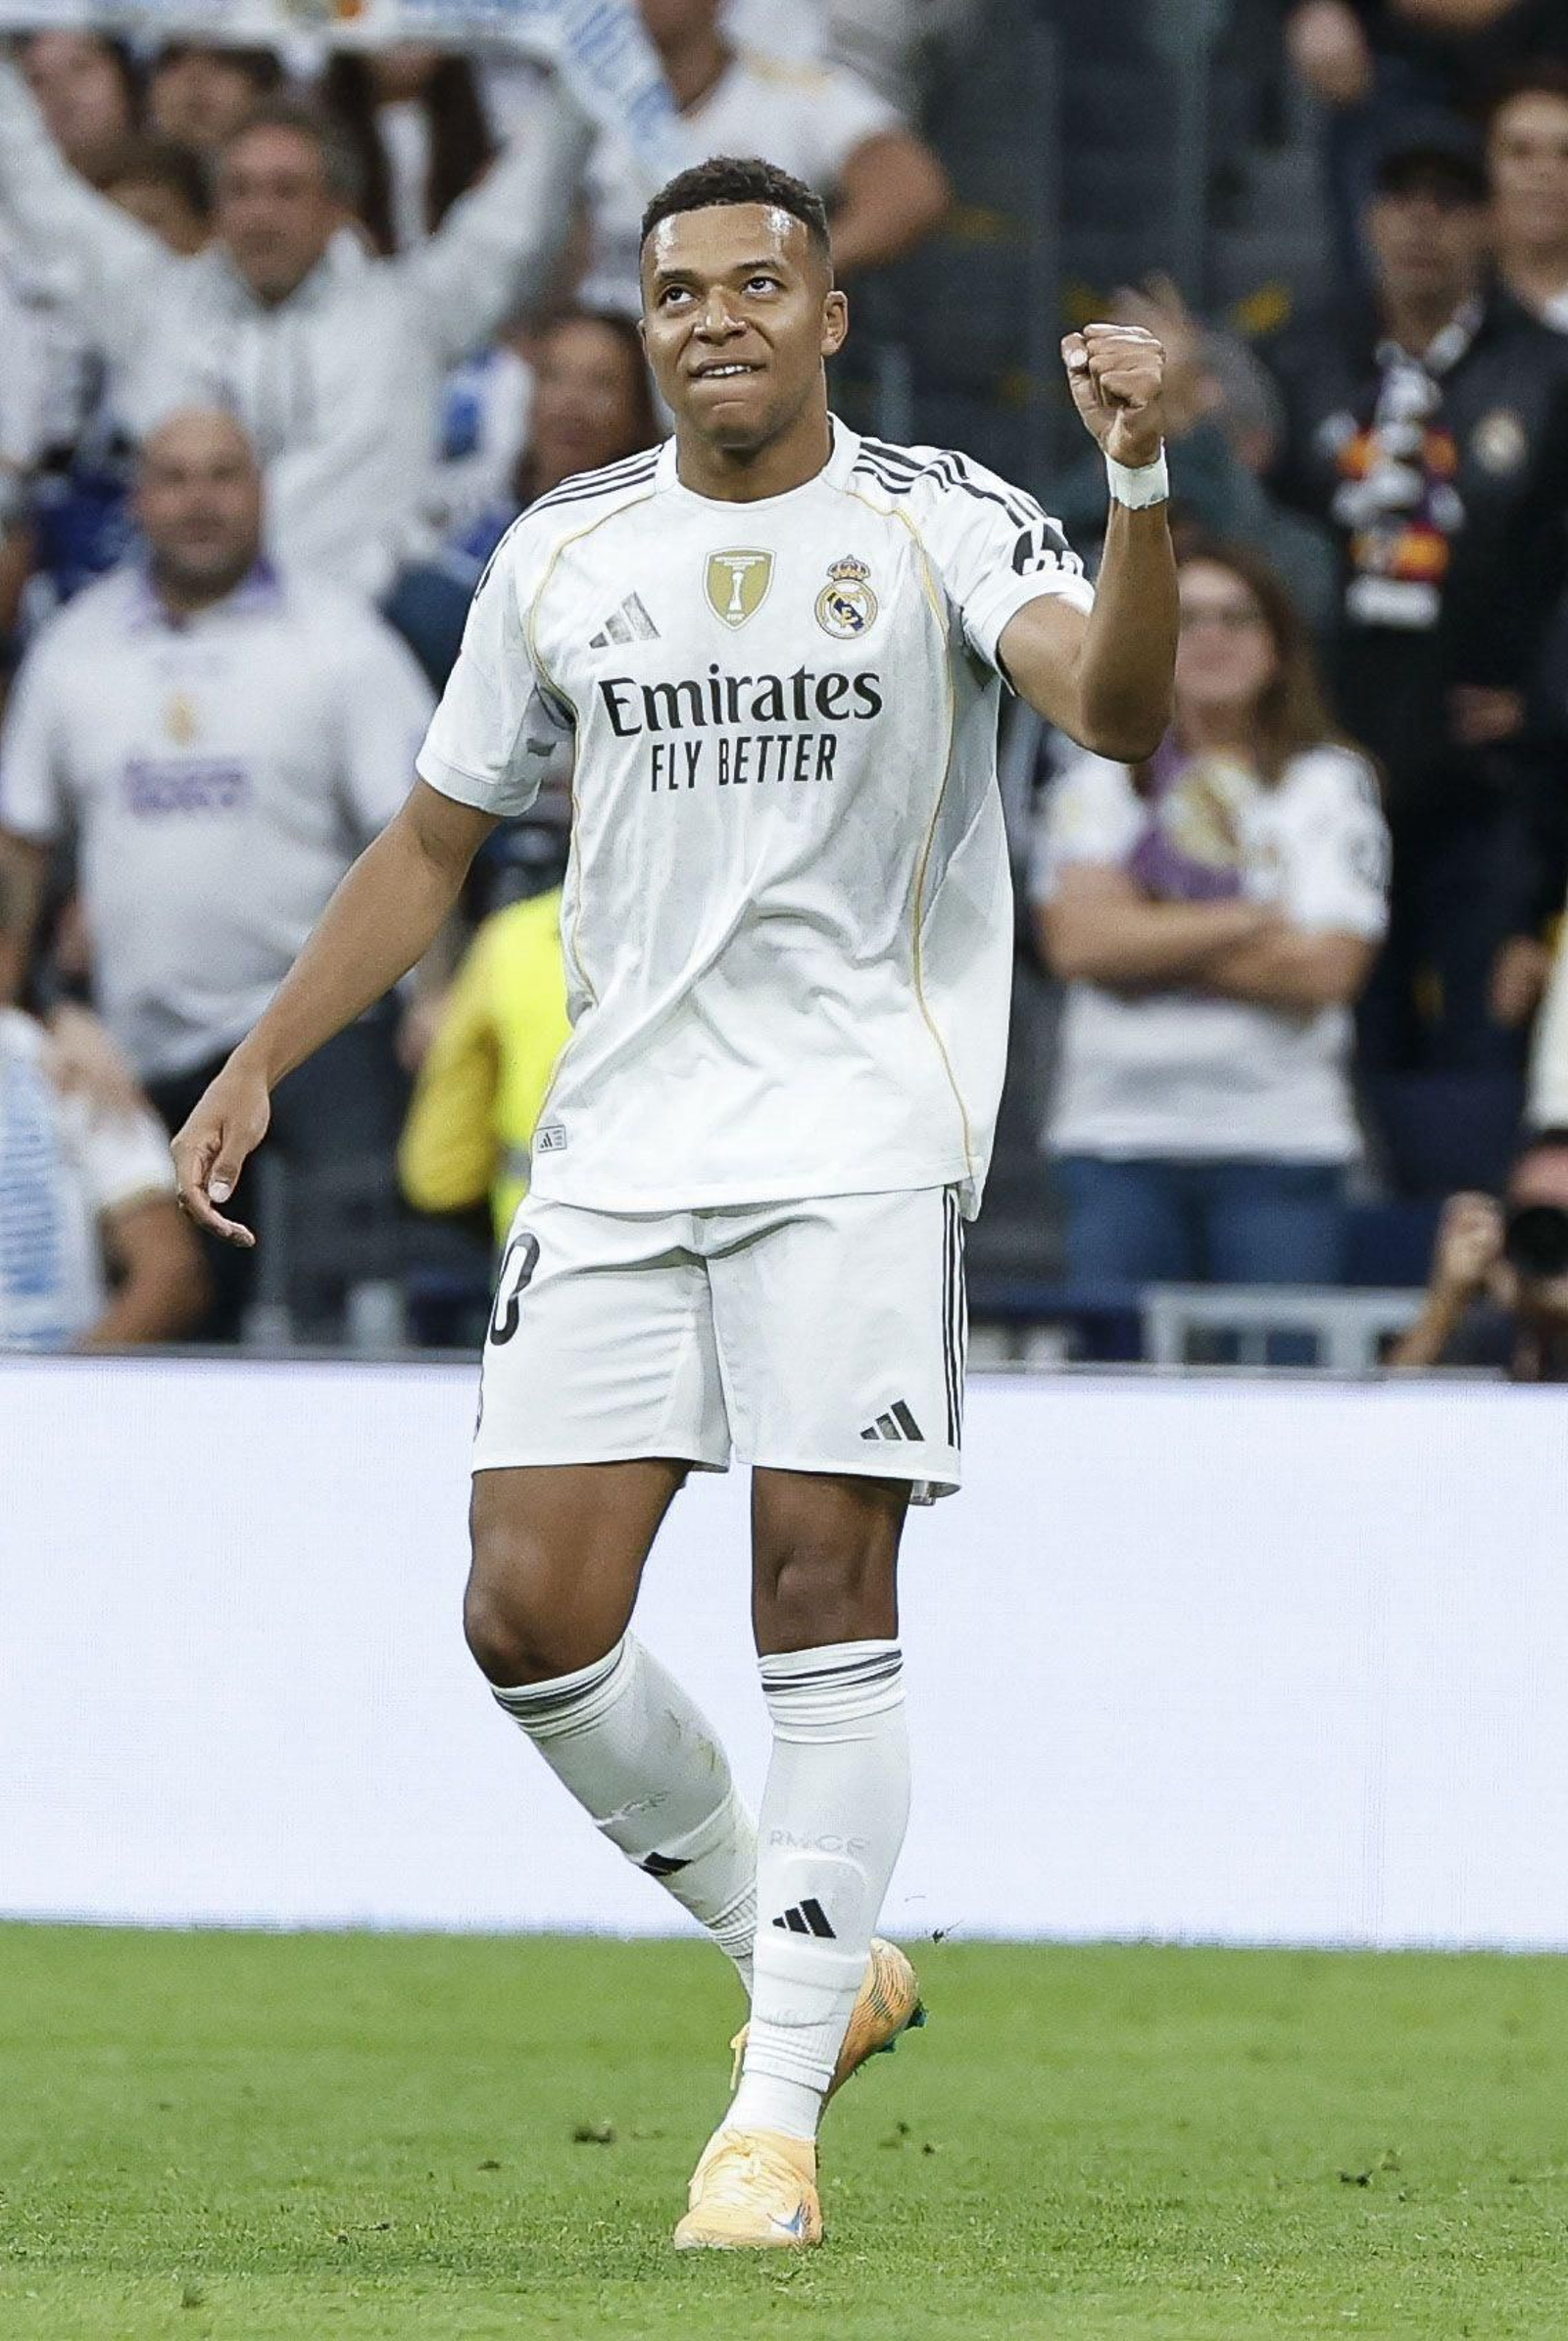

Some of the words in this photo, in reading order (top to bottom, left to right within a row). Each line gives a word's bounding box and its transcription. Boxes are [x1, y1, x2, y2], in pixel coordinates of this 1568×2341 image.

[598, 663, 883, 737] Emirates
[651, 739, 702, 792] FLY
[718, 734, 837, 786] BETTER
